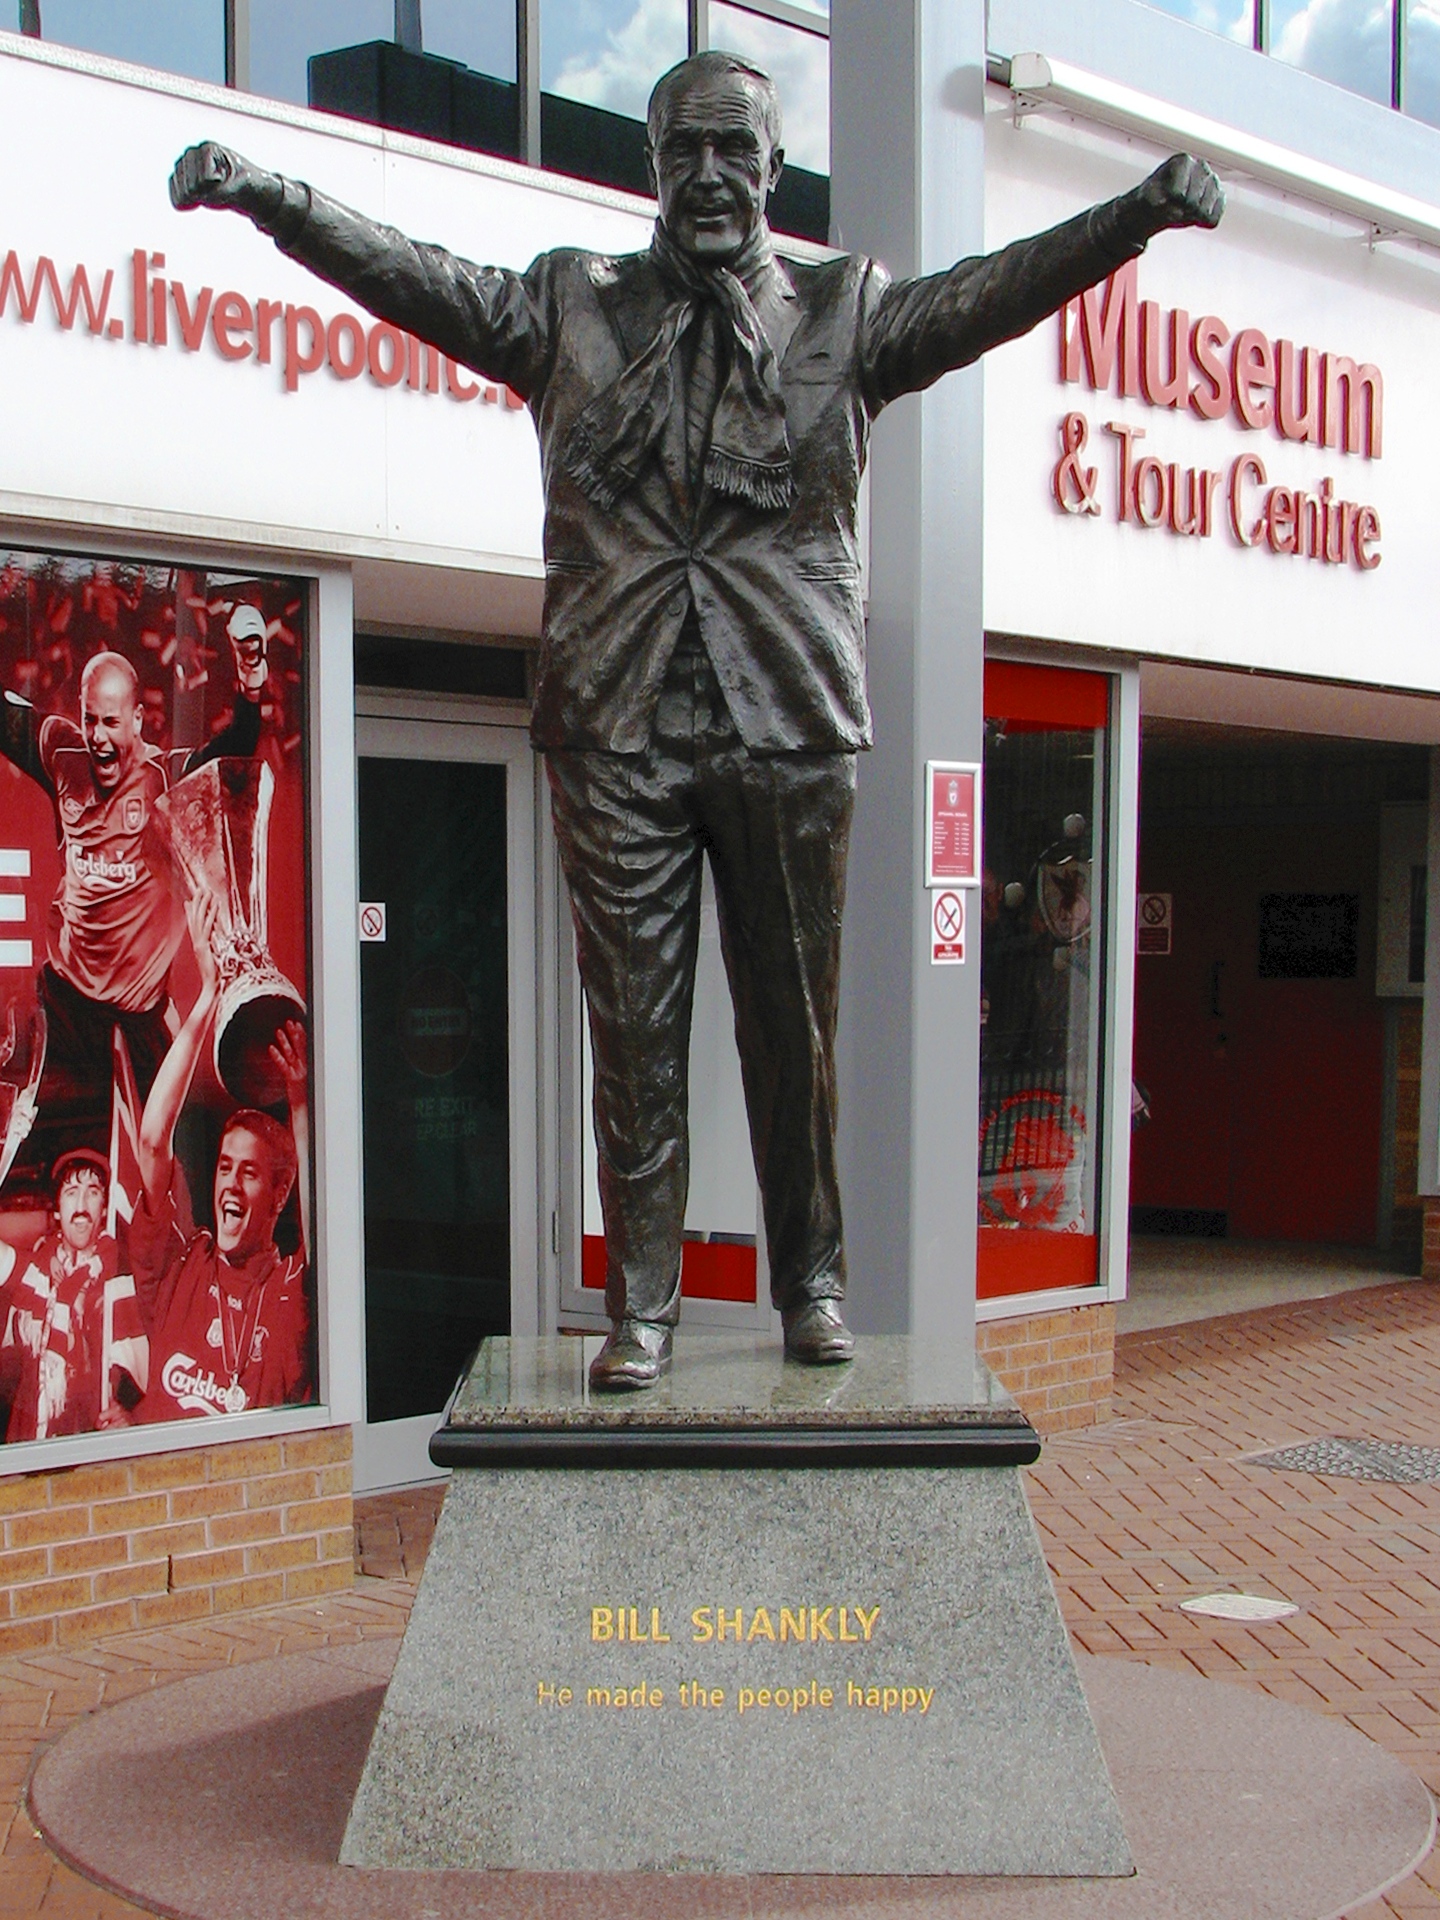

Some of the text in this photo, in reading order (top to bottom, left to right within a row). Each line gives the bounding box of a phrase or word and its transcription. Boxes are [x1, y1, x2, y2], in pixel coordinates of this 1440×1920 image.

[0, 248, 524, 411] ww.liverpoolc.
[1060, 257, 1384, 460] Museum
[1052, 411, 1383, 571] & Tour Centre
[70, 843, 137, 884] Carlsberg
[161, 1351, 238, 1405] Carlsbe
[590, 1605, 882, 1643] BILL SHANKLY
[537, 1679, 936, 1716] He made the people happy
